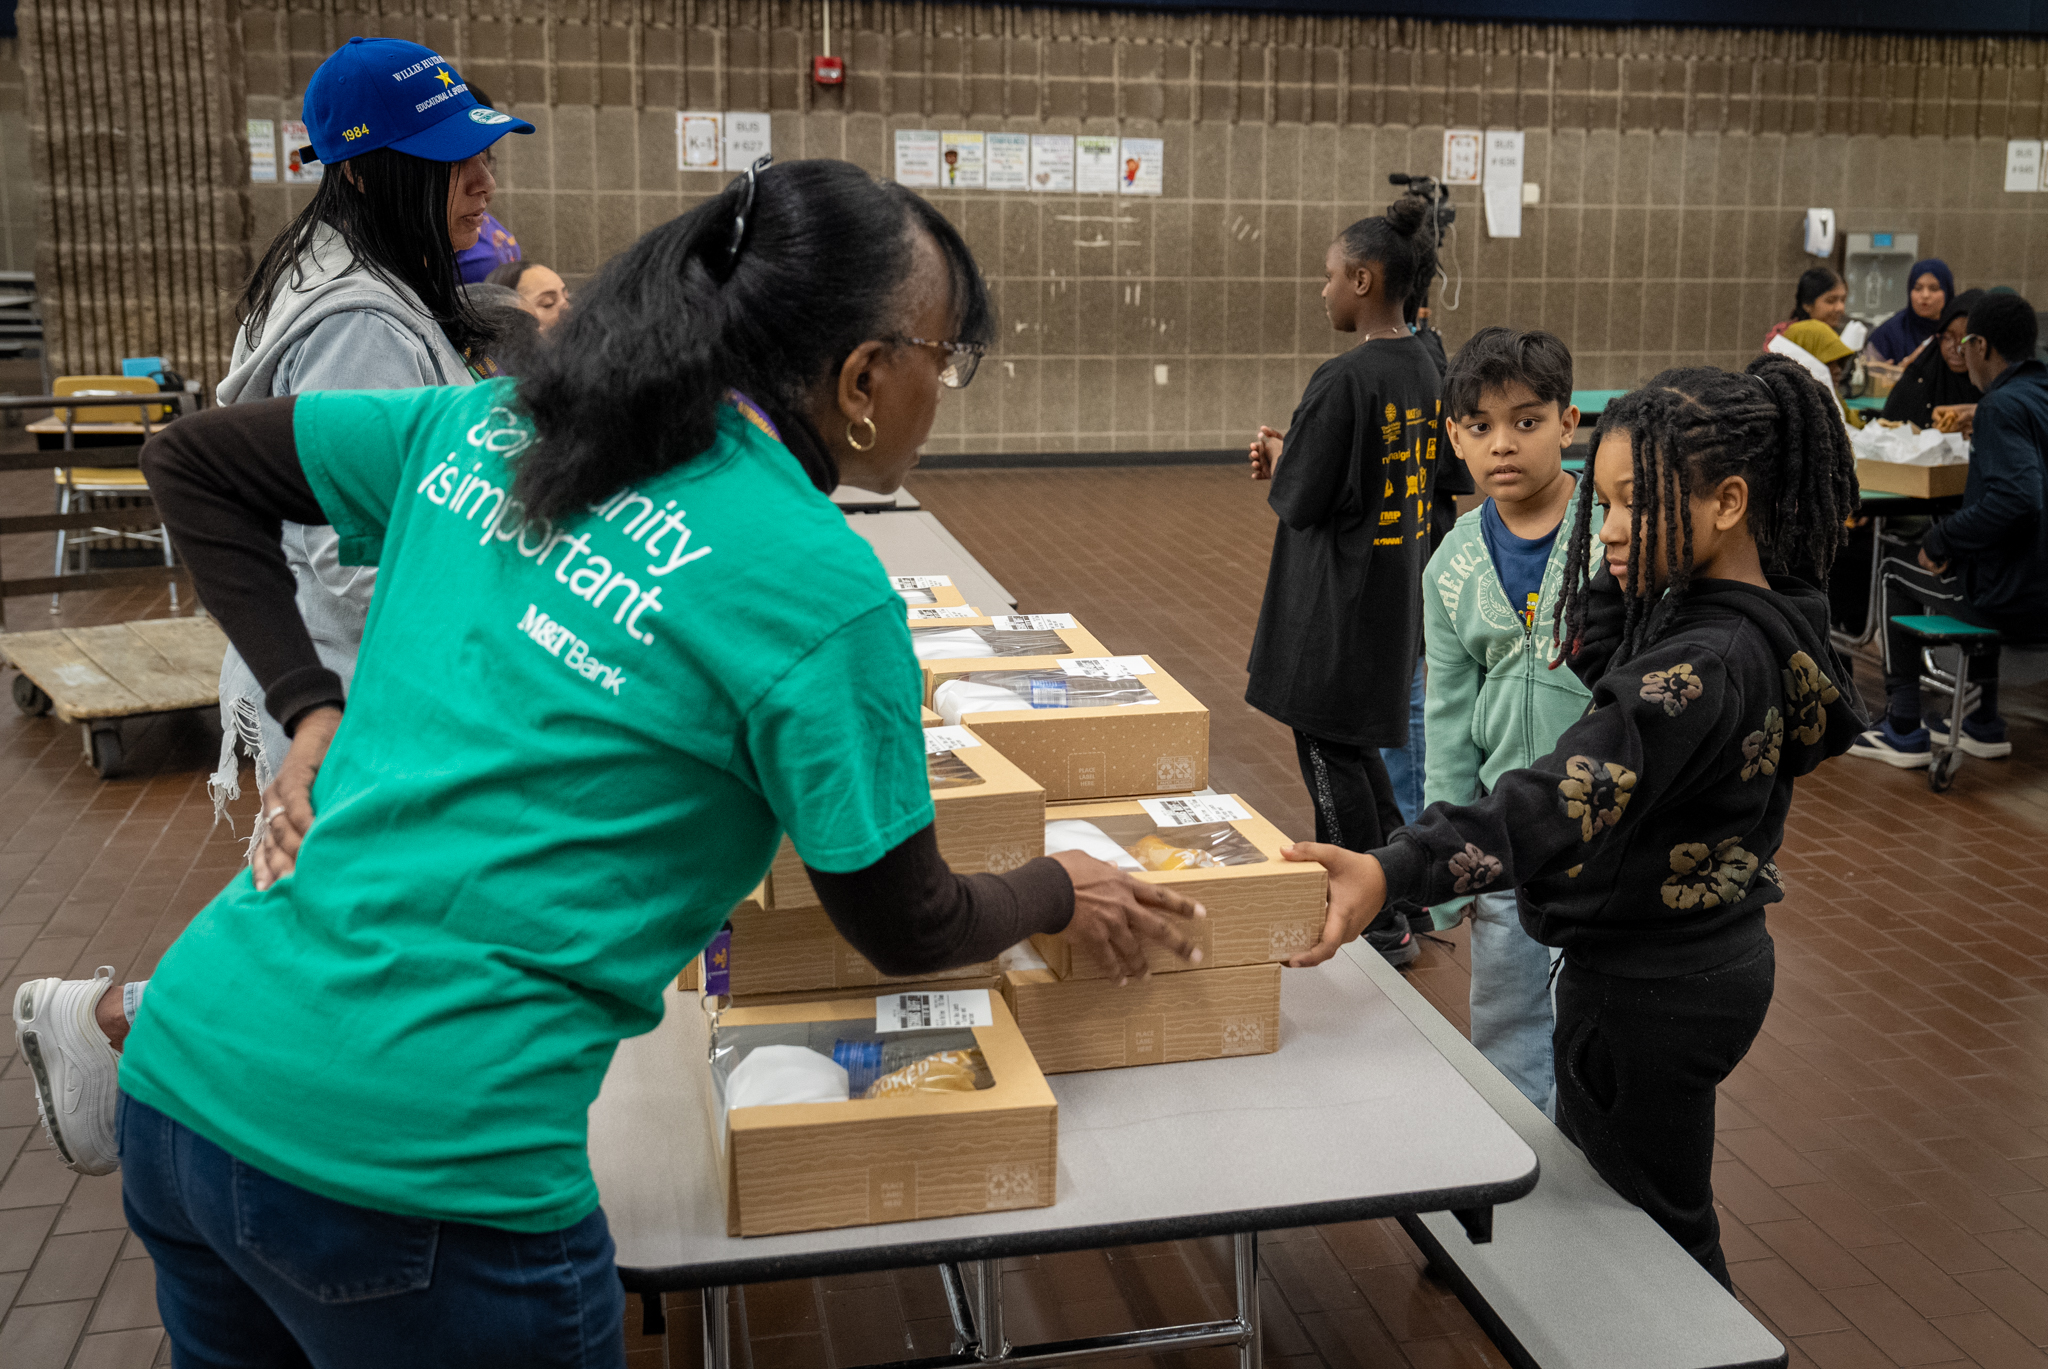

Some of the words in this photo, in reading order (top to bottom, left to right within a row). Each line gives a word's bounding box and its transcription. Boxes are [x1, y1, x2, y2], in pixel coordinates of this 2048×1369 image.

[392, 61, 424, 82] WILLIE
[342, 123, 369, 142] 1984
[735, 120, 760, 133] BUS
[689, 135, 713, 150] K-1
[516, 603, 577, 657] M&T
[564, 639, 627, 696] Bank
[1135, 1030, 1154, 1038] PLACE
[1136, 1037, 1154, 1046] LABEL
[1137, 1045, 1153, 1053] HERE
